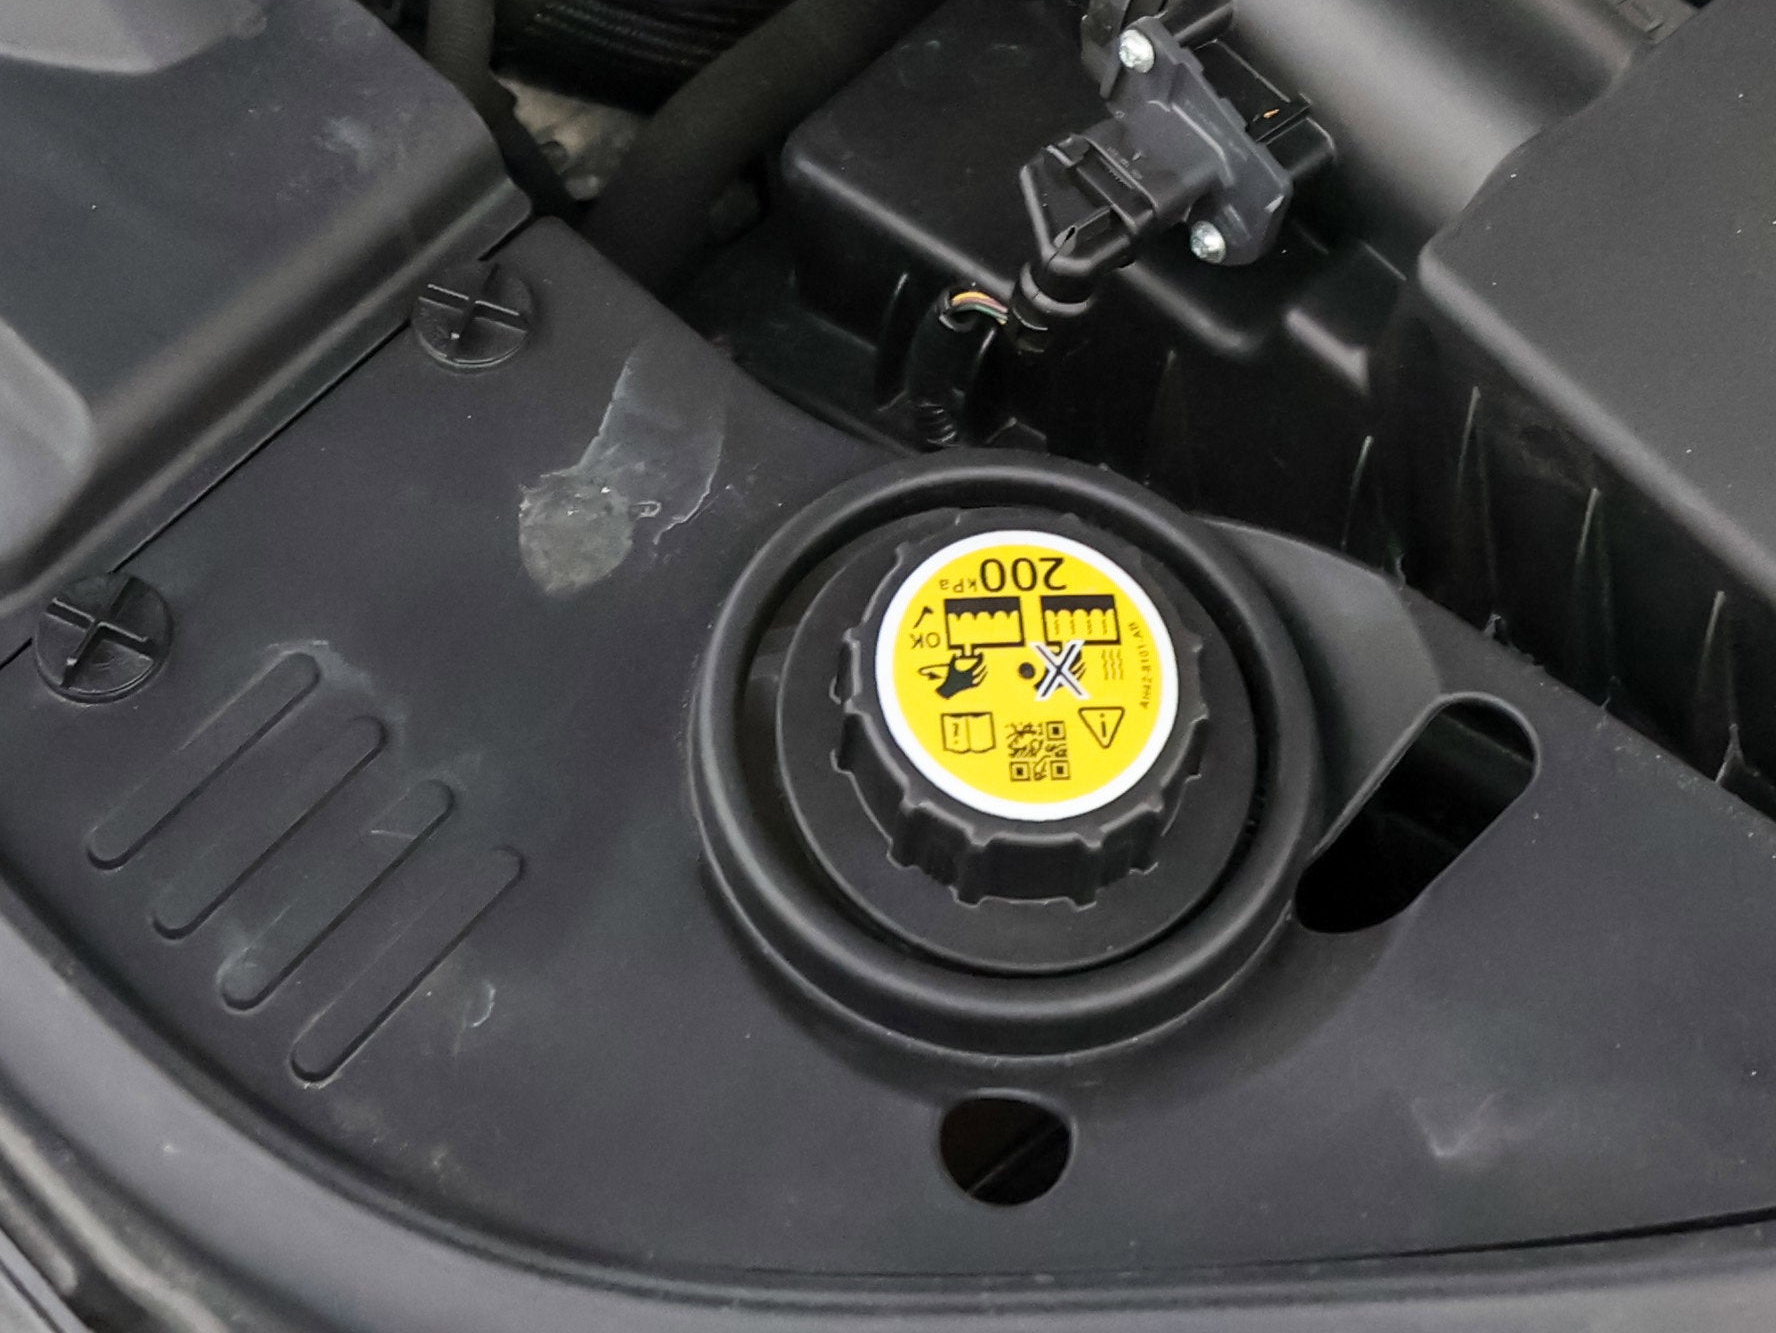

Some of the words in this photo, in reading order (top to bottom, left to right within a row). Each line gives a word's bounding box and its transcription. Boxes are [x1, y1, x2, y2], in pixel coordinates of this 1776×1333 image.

[979, 557, 1068, 593] 200
[938, 576, 978, 593] kPa
[909, 631, 941, 649] OK
